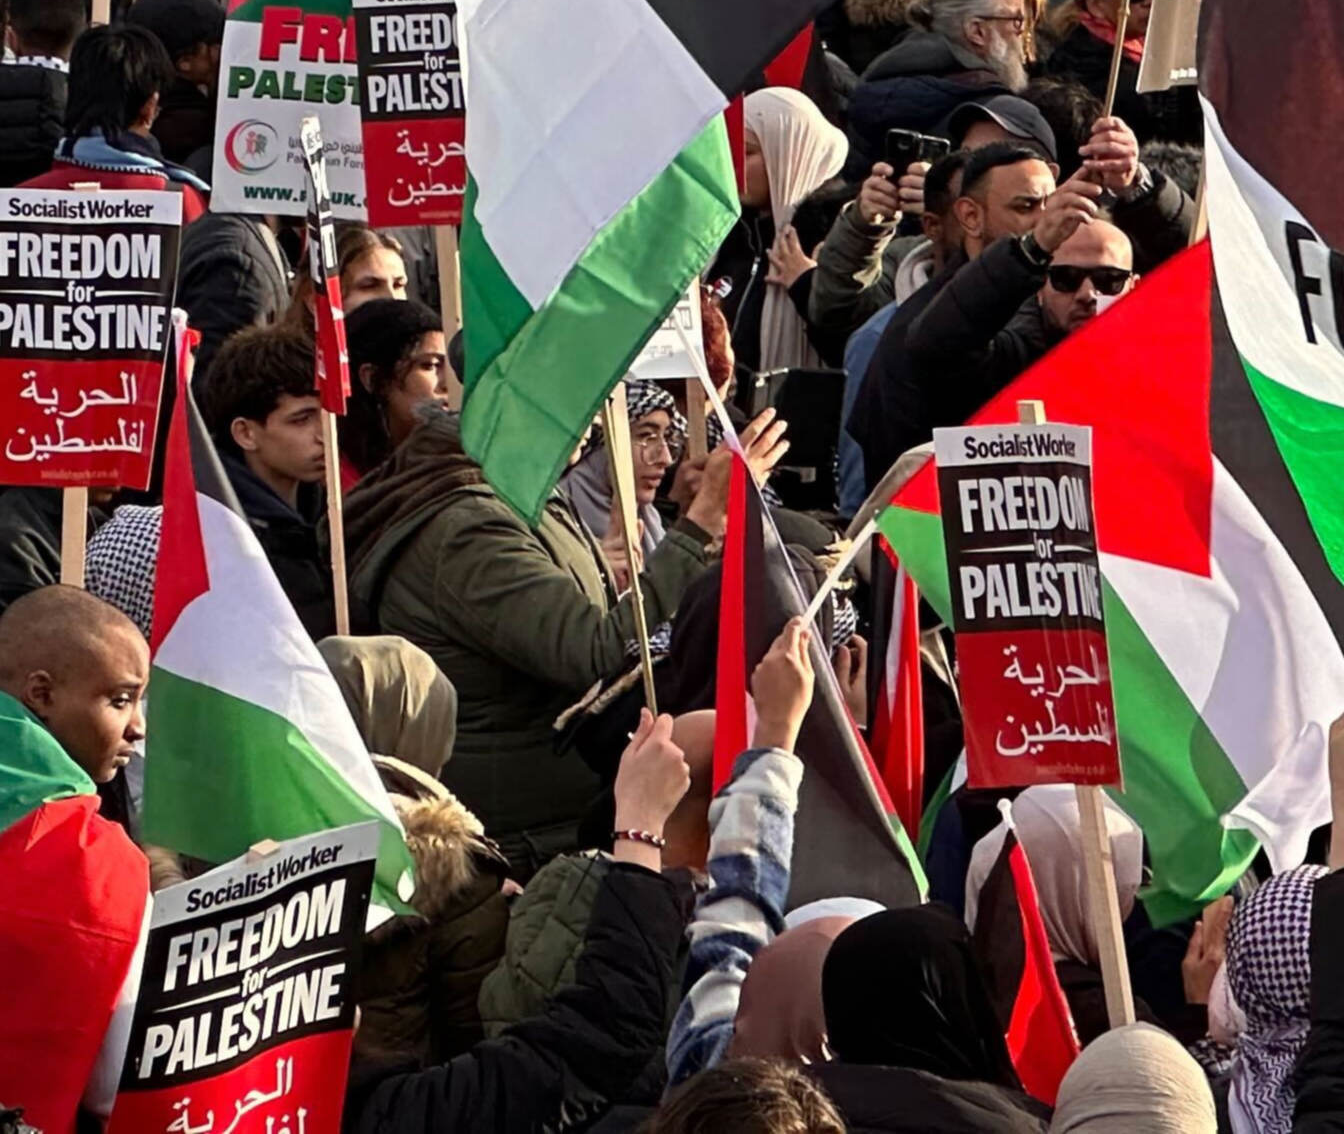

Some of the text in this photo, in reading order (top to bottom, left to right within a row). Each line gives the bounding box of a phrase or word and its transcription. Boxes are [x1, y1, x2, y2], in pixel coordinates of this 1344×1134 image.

[66, 279, 96, 304] for
[958, 474, 1090, 534] FREEDOM
[960, 561, 1103, 620] PALESTINE
[162, 878, 347, 993] FREEDOM
[241, 966, 268, 998] for
[137, 962, 347, 1080] PALESTINE
